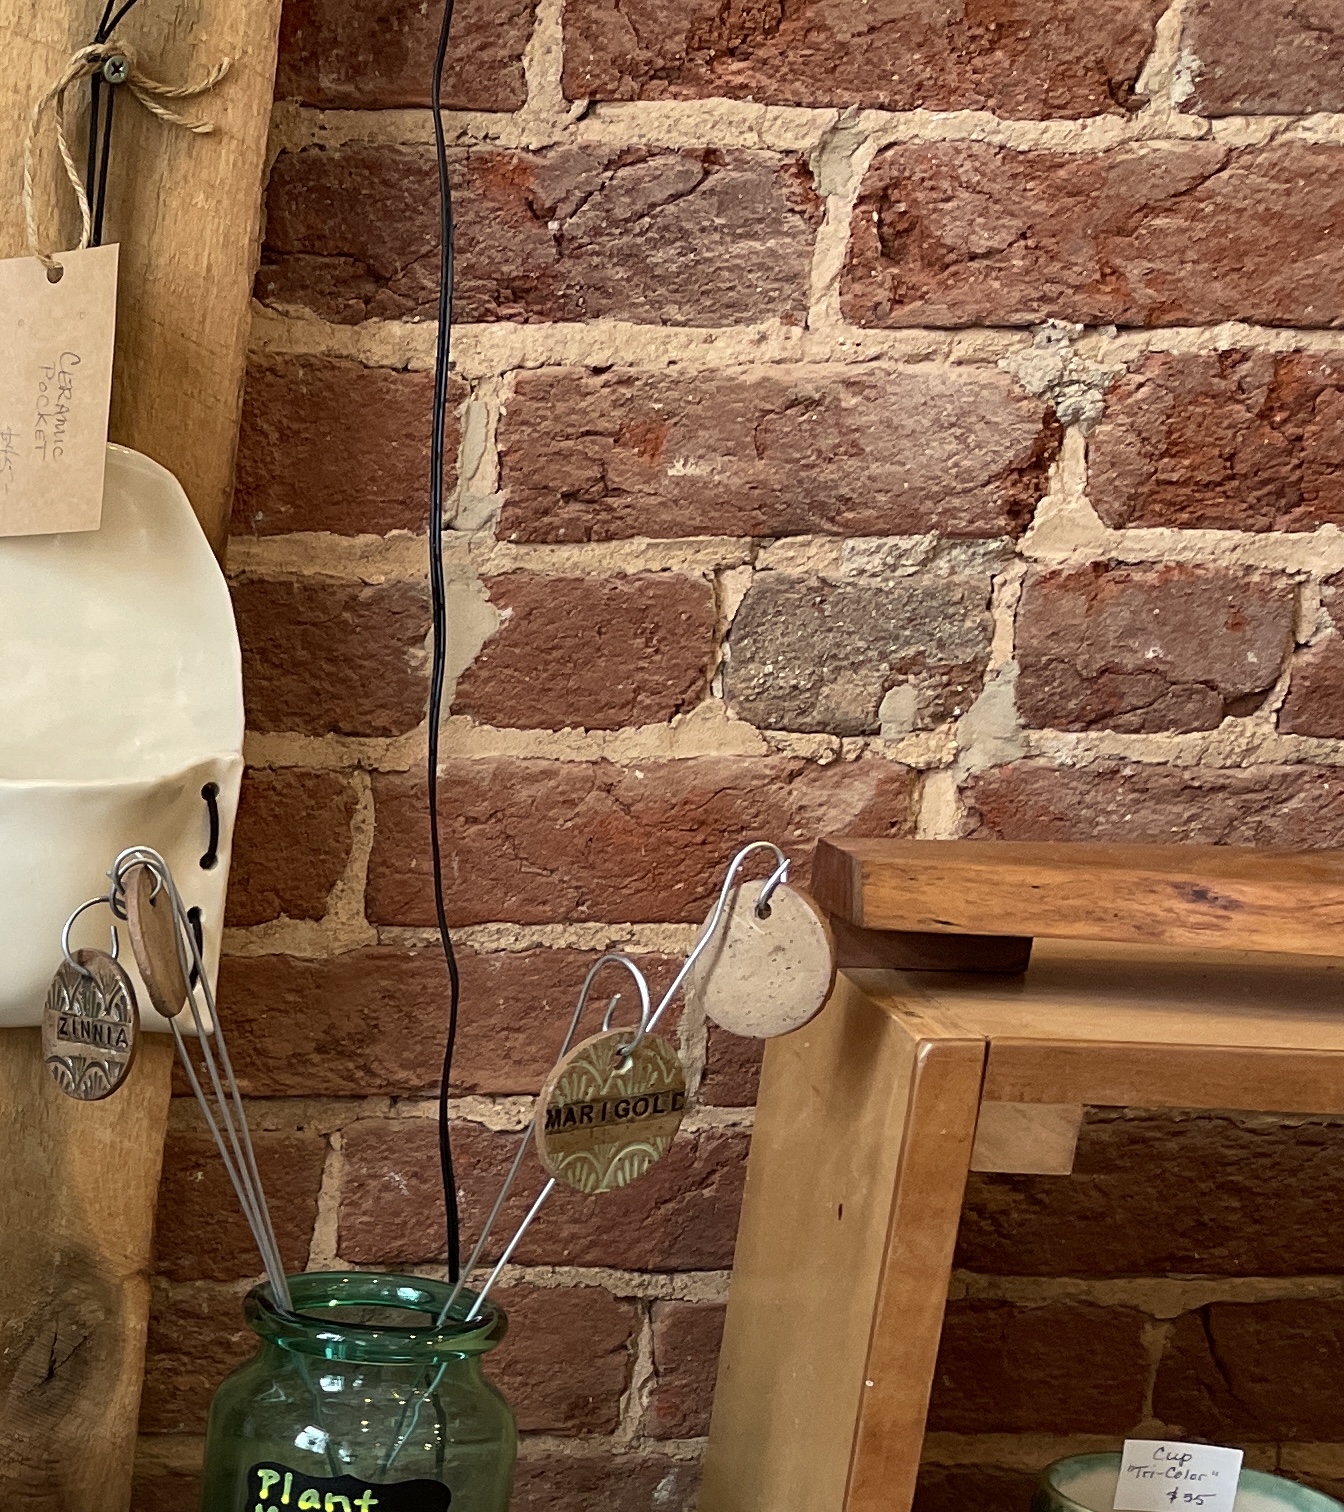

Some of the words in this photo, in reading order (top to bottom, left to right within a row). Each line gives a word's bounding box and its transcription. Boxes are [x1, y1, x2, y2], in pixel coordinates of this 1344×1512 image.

[34, 360, 56, 461] POCKET
[56, 1016, 128, 1048] ZINNIA
[544, 1092, 685, 1130] MARIGOLD
[1152, 1446, 1193, 1468] Cup
